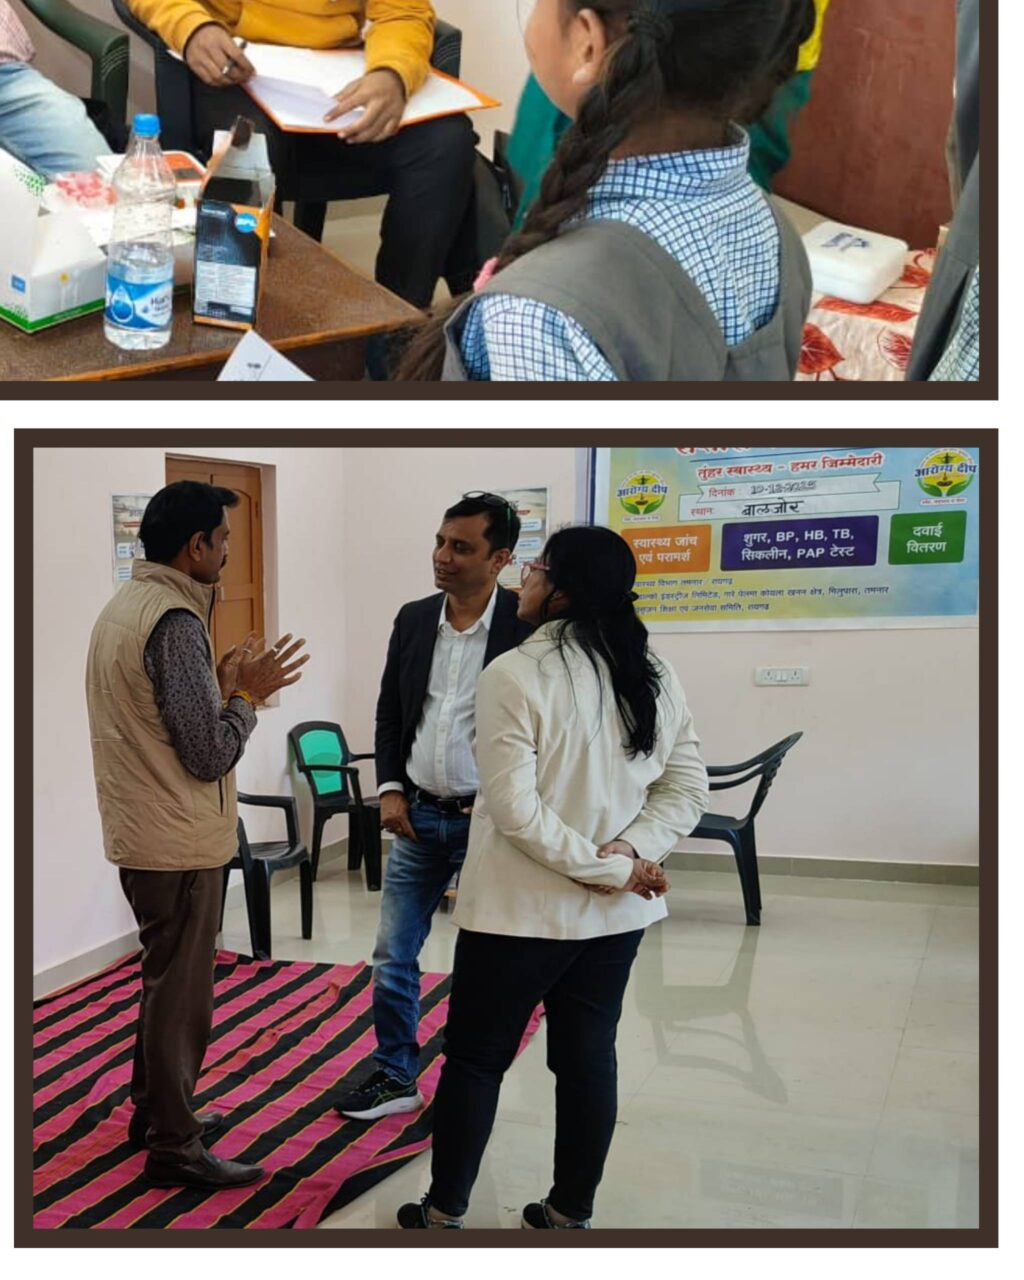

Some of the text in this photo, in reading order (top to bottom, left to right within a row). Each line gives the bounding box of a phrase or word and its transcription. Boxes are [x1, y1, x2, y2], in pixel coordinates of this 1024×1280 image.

[790, 457, 818, 472] हमर
[822, 452, 883, 470] जिम्मेदारी
[776, 531, 800, 543] BP,
[804, 530, 828, 542] HB,
[832, 529, 855, 541] TB,
[912, 522, 944, 537] दवाई
[796, 548, 825, 559] PAP
[906, 540, 948, 554] वितरण
